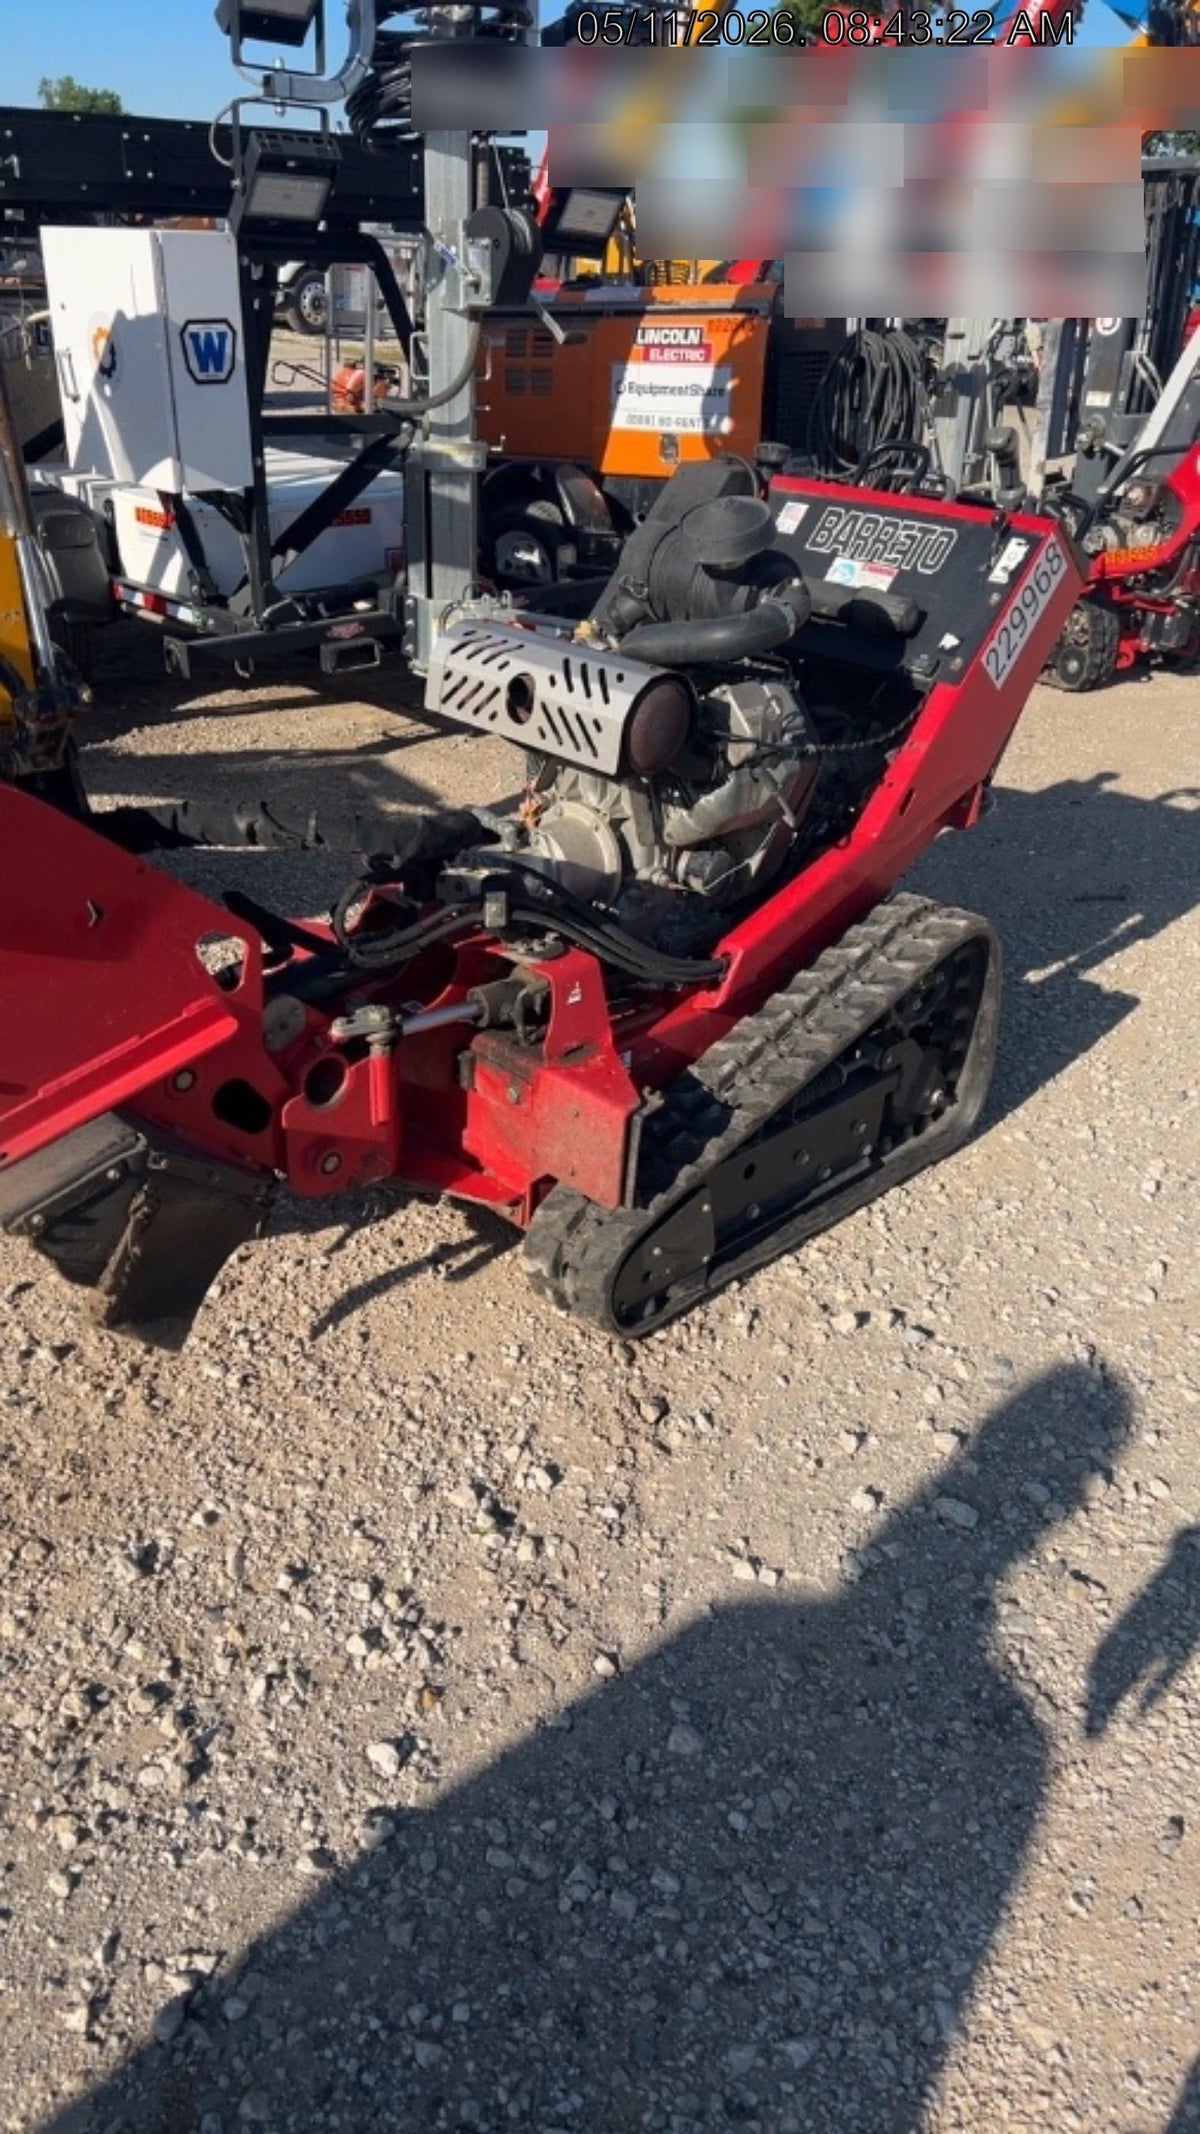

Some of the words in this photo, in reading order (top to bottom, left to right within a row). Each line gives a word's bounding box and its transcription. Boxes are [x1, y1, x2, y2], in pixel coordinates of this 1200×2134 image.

[637, 329, 700, 344] LINCOLN
[649, 348, 705, 361] ELECTRIC
[628, 382, 725, 397] EquipmentShare
[805, 507, 959, 574] BARRETO
[986, 542, 1063, 681] 229968
